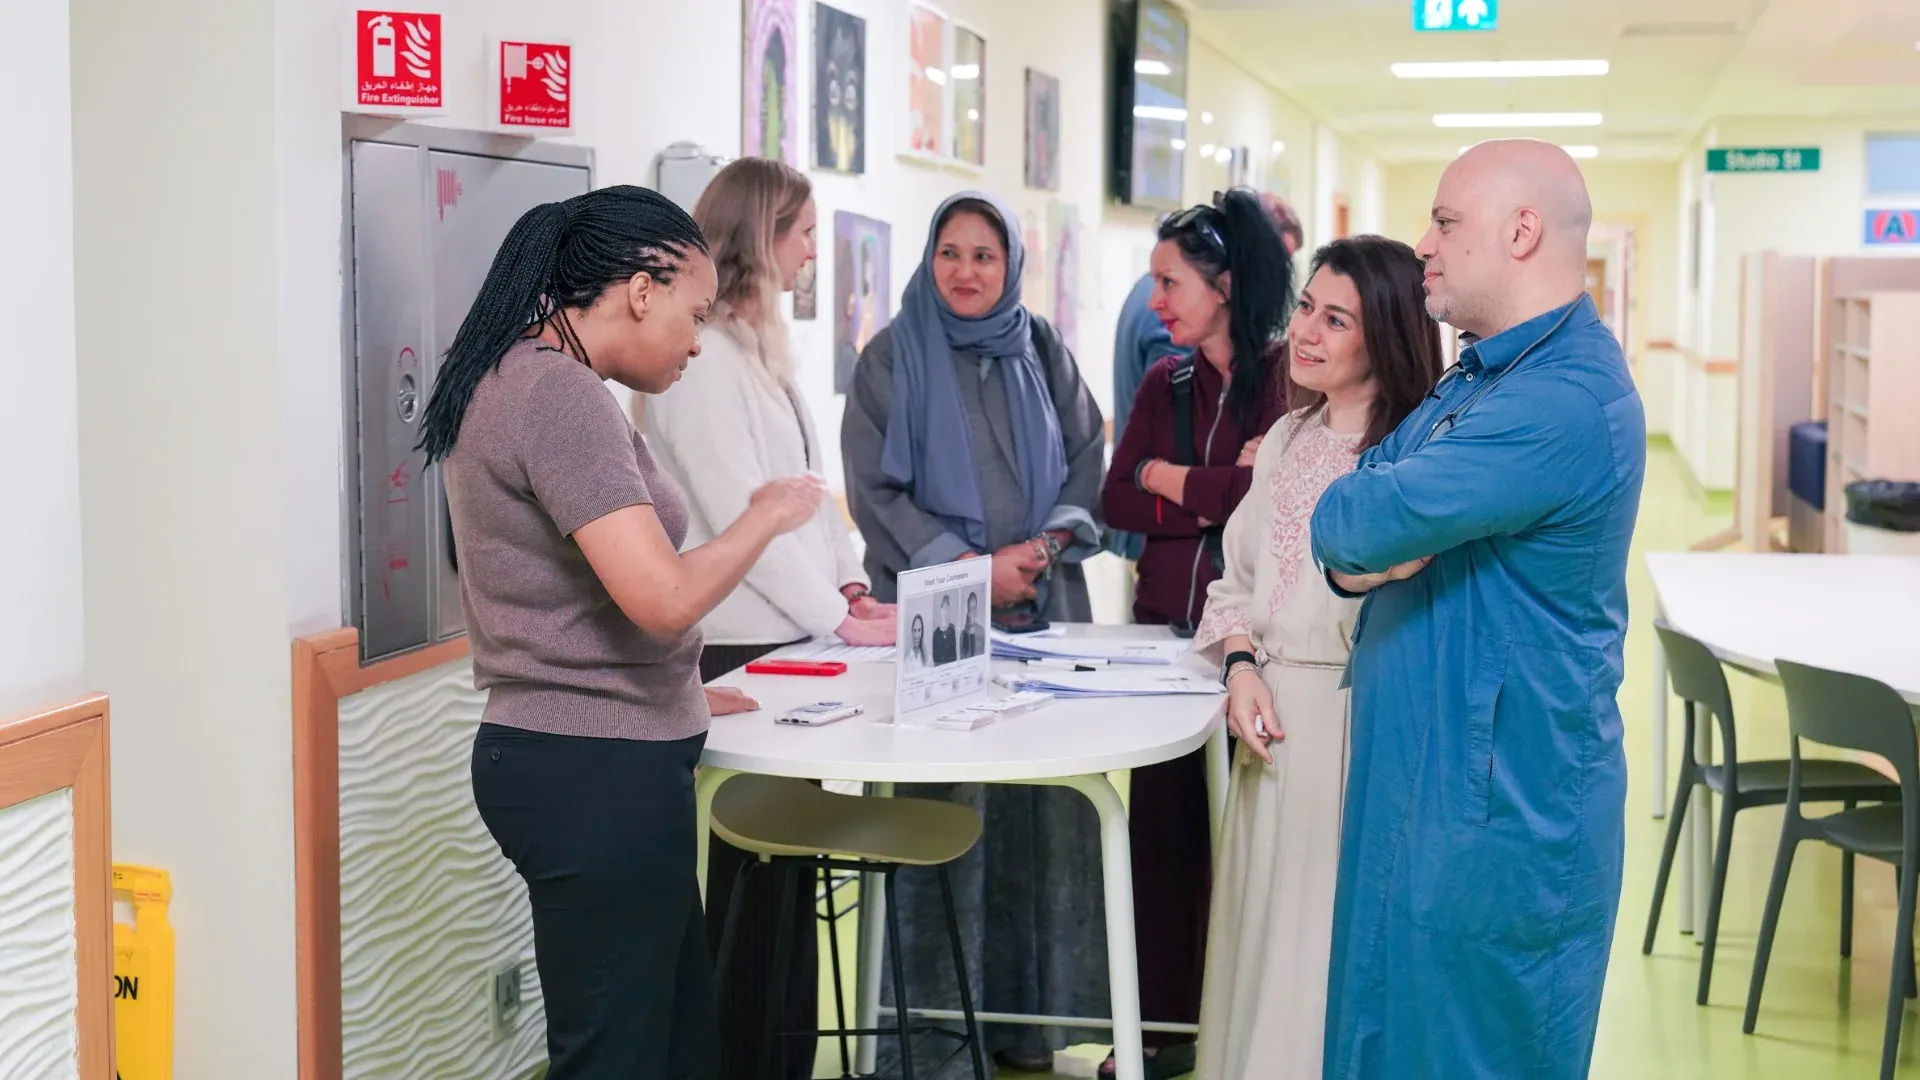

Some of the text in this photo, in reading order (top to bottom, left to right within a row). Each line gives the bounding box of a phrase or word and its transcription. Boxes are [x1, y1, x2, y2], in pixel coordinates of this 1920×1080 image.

[361, 93, 439, 106] Fire Extinguisher
[504, 114, 522, 123] Fire
[524, 115, 546, 124] hose
[1725, 150, 1780, 170] Studio
